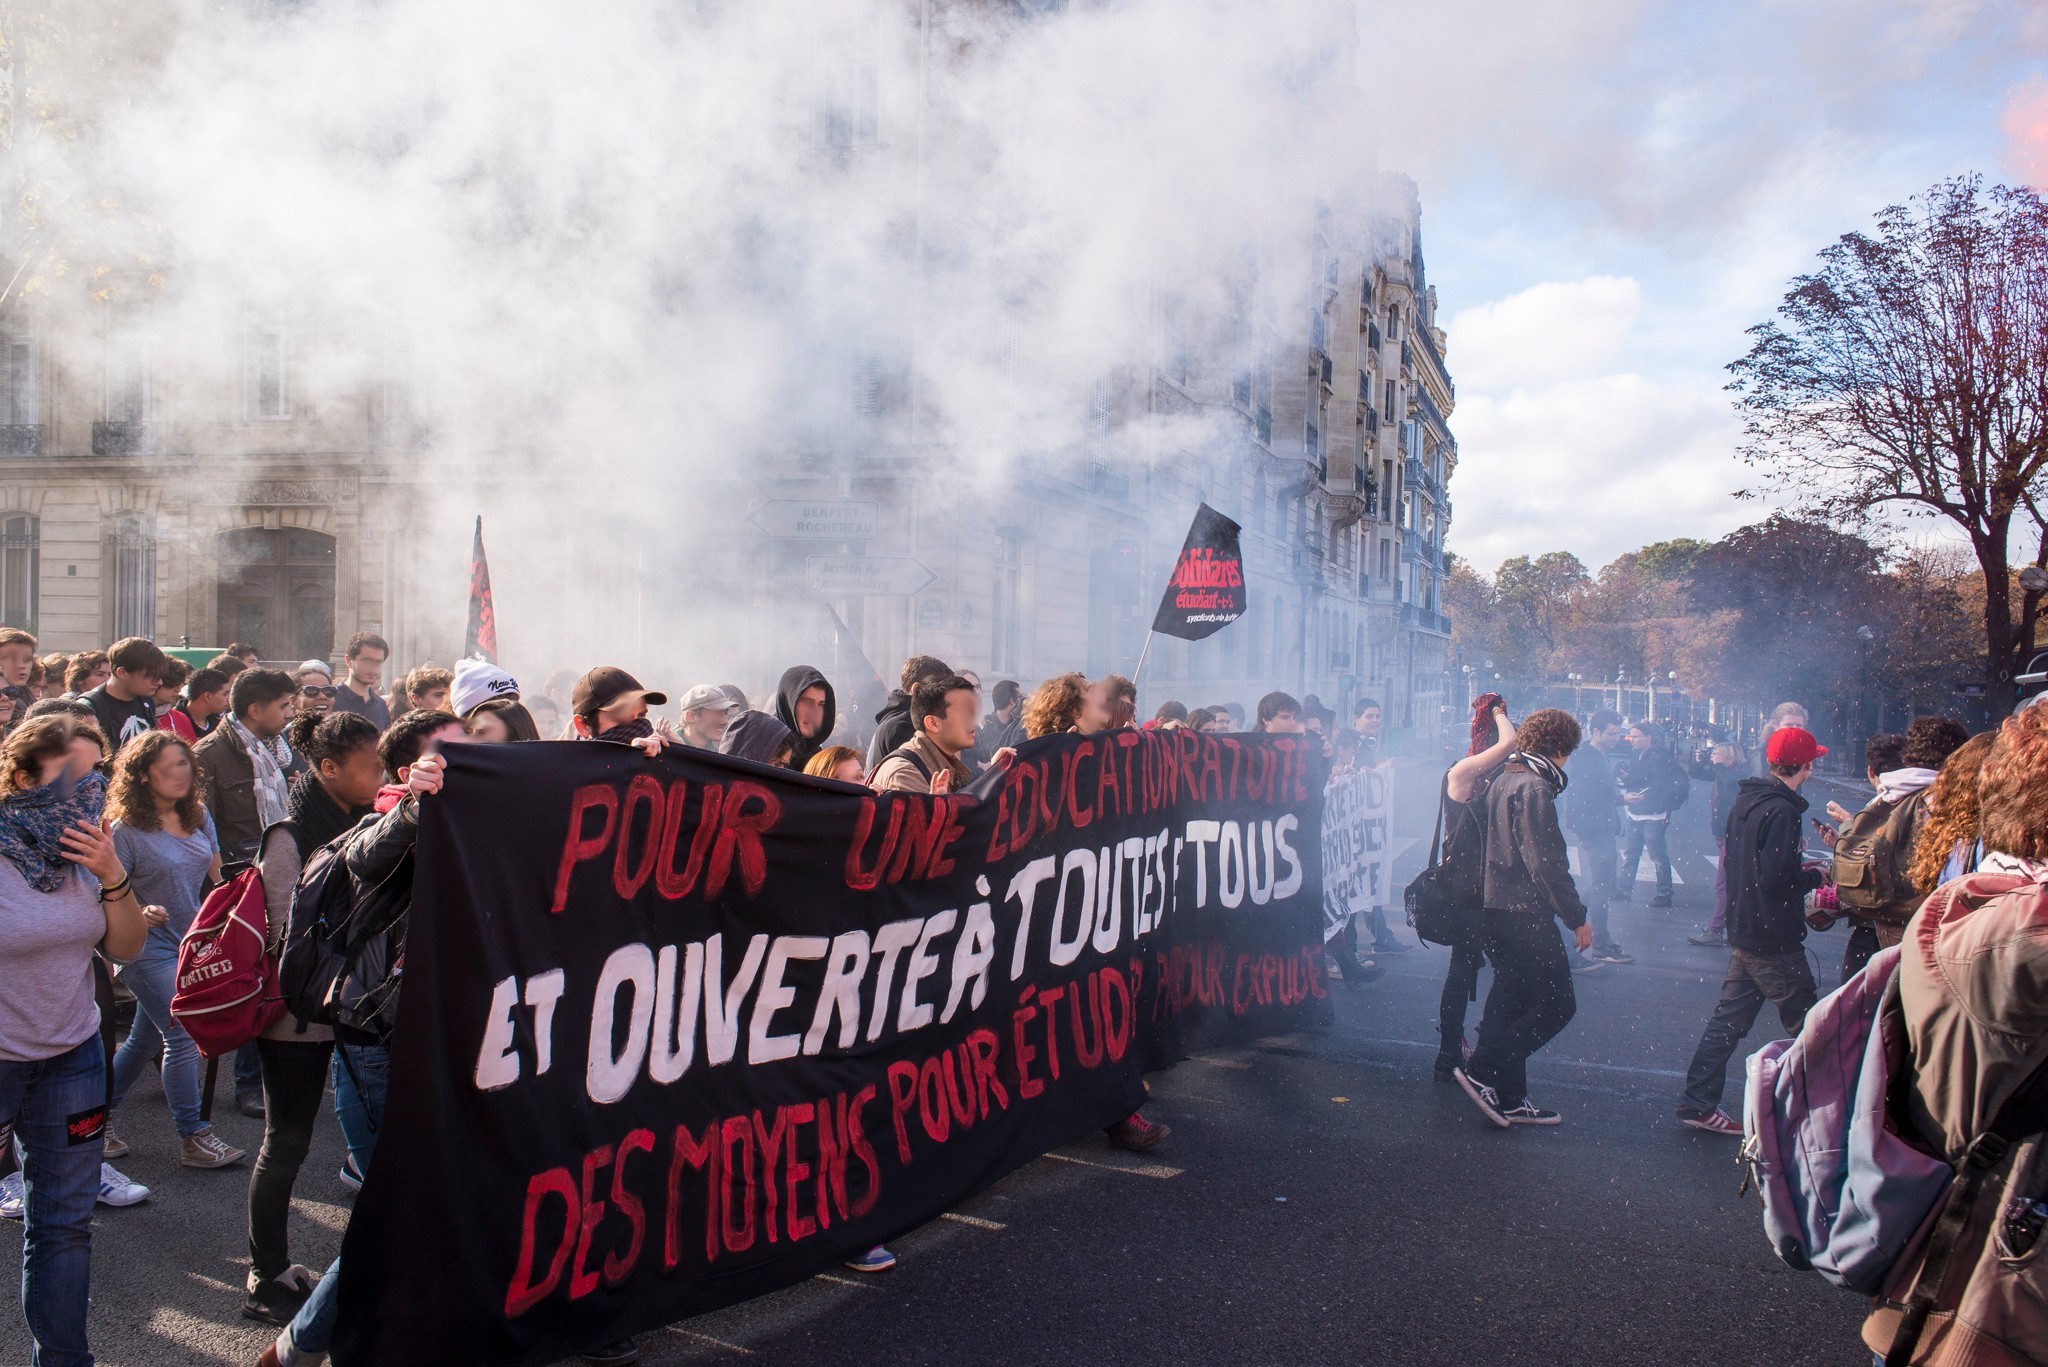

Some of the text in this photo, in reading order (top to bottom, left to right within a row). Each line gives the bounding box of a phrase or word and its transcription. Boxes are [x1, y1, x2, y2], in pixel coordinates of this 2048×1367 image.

[796, 521, 873, 534] ROCHEREAU
[820, 562, 881, 575] Jardin du
[550, 774, 782, 914] POUR
[844, 794, 981, 891] UNE
[1179, 728, 1310, 804] RATUITE
[180, 958, 234, 989] UNITED
[474, 967, 565, 1092] ET
[586, 908, 958, 1104] OUVERTE
[938, 873, 996, 1025] À
[1004, 827, 1169, 982] TOUTES
[1185, 813, 1304, 909] TOUS
[505, 1127, 655, 1320] DES
[664, 1083, 882, 1272] MOYENS
[887, 1028, 1010, 1165] POUR
